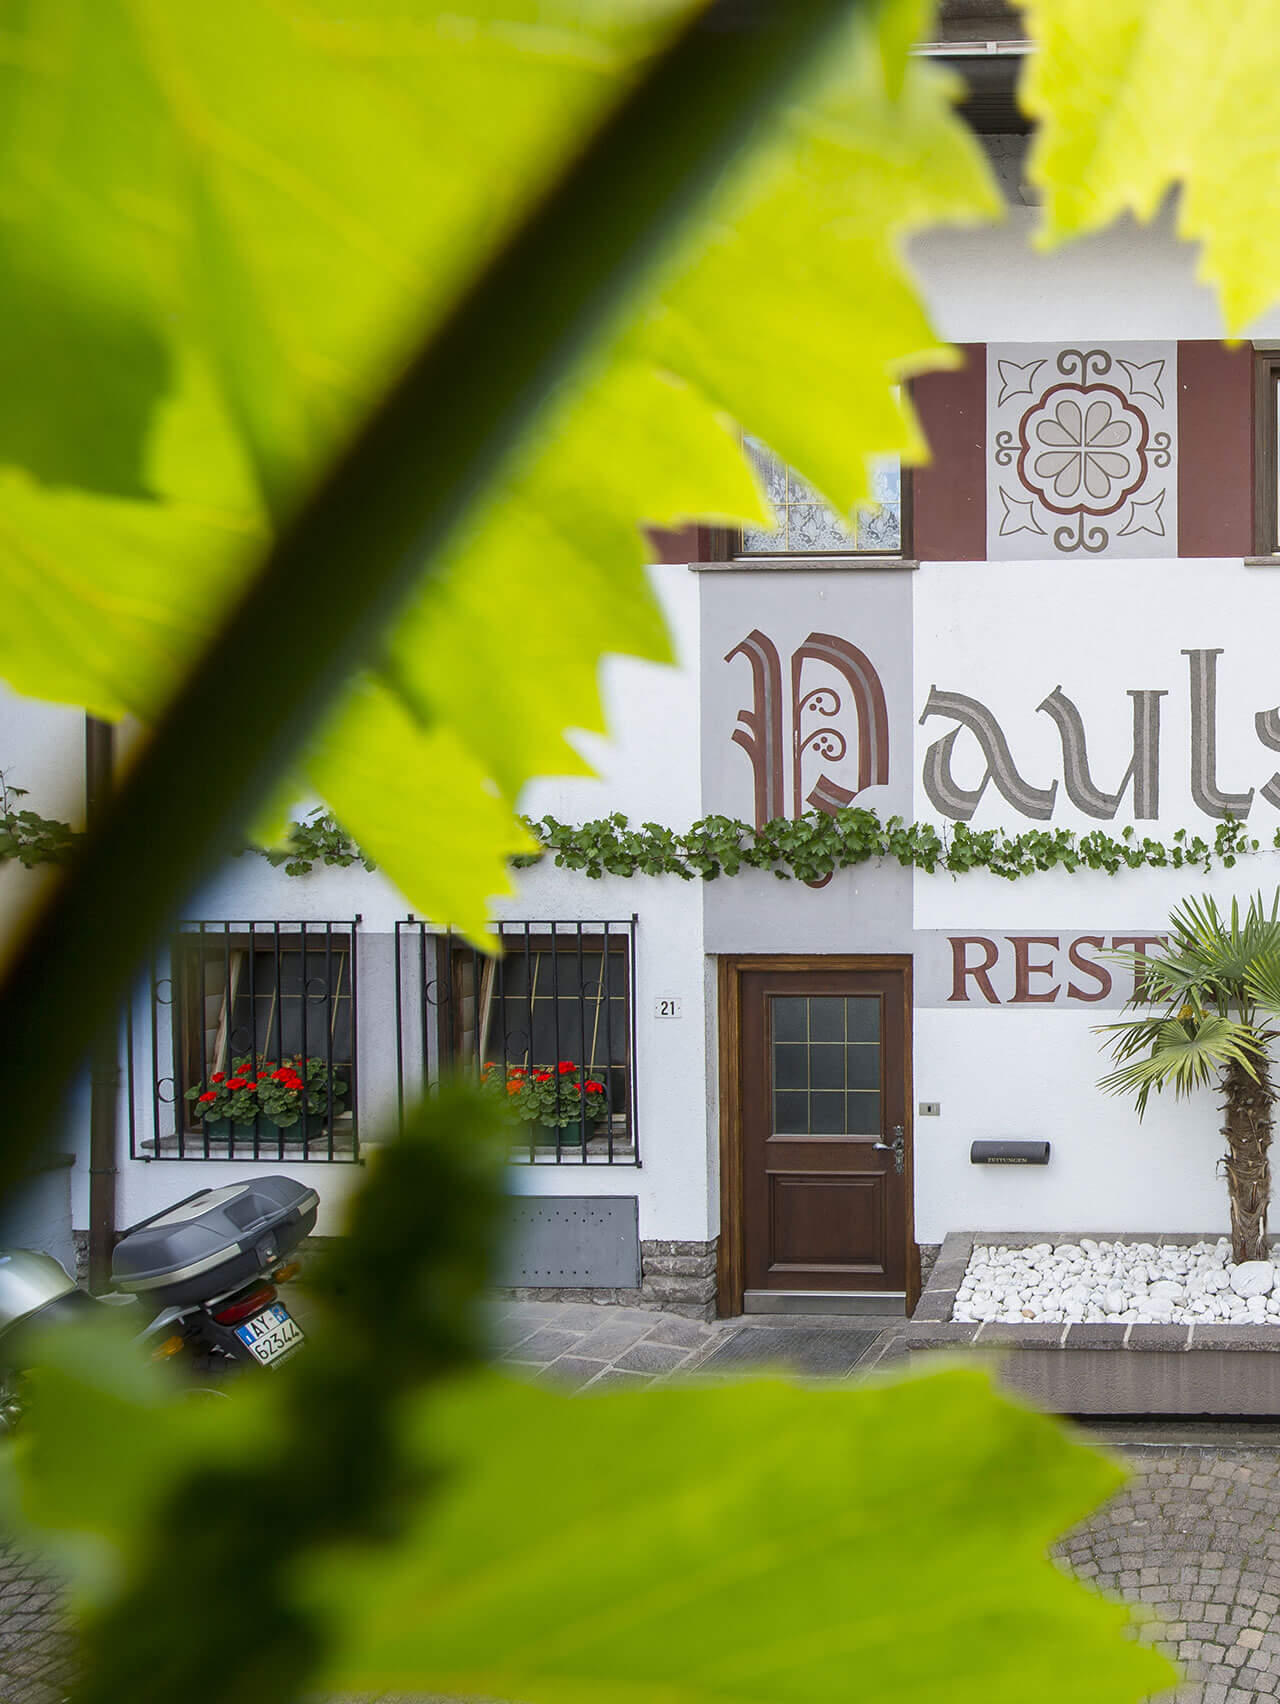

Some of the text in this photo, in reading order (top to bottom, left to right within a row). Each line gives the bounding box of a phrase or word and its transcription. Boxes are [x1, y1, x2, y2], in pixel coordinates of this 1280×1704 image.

[661, 1001, 675, 1015] 21
[250, 1315, 270, 1338] AY
[255, 1322, 300, 1360] 62344
